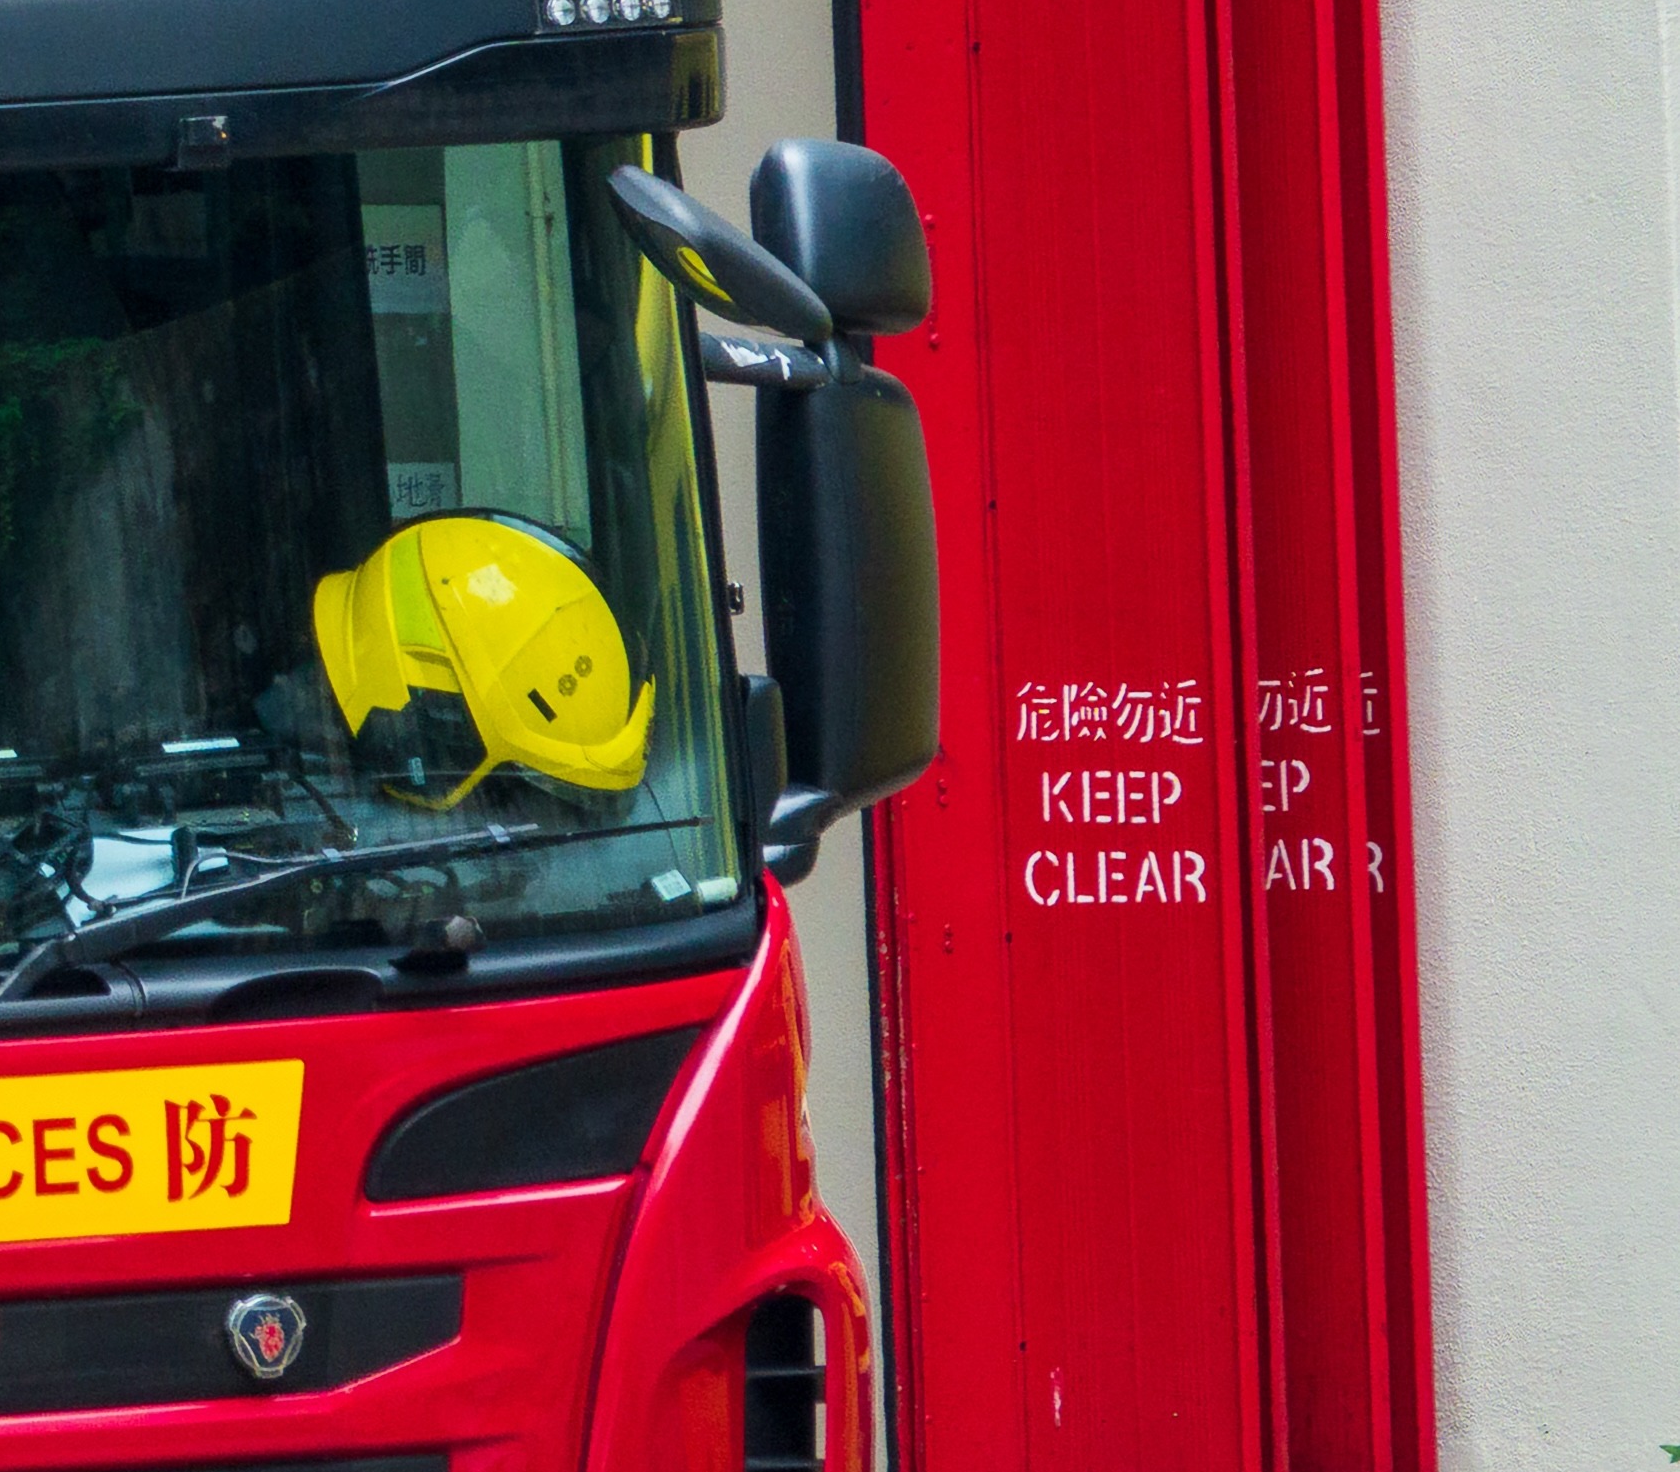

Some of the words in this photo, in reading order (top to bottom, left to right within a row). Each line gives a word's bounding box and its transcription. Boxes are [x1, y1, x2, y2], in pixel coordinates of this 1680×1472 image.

[1015, 679, 1204, 744] 危險勿近
[1041, 769, 1182, 824] KEEP
[1024, 848, 1206, 906] CLEAR
[164, 1093, 258, 1202] 防
